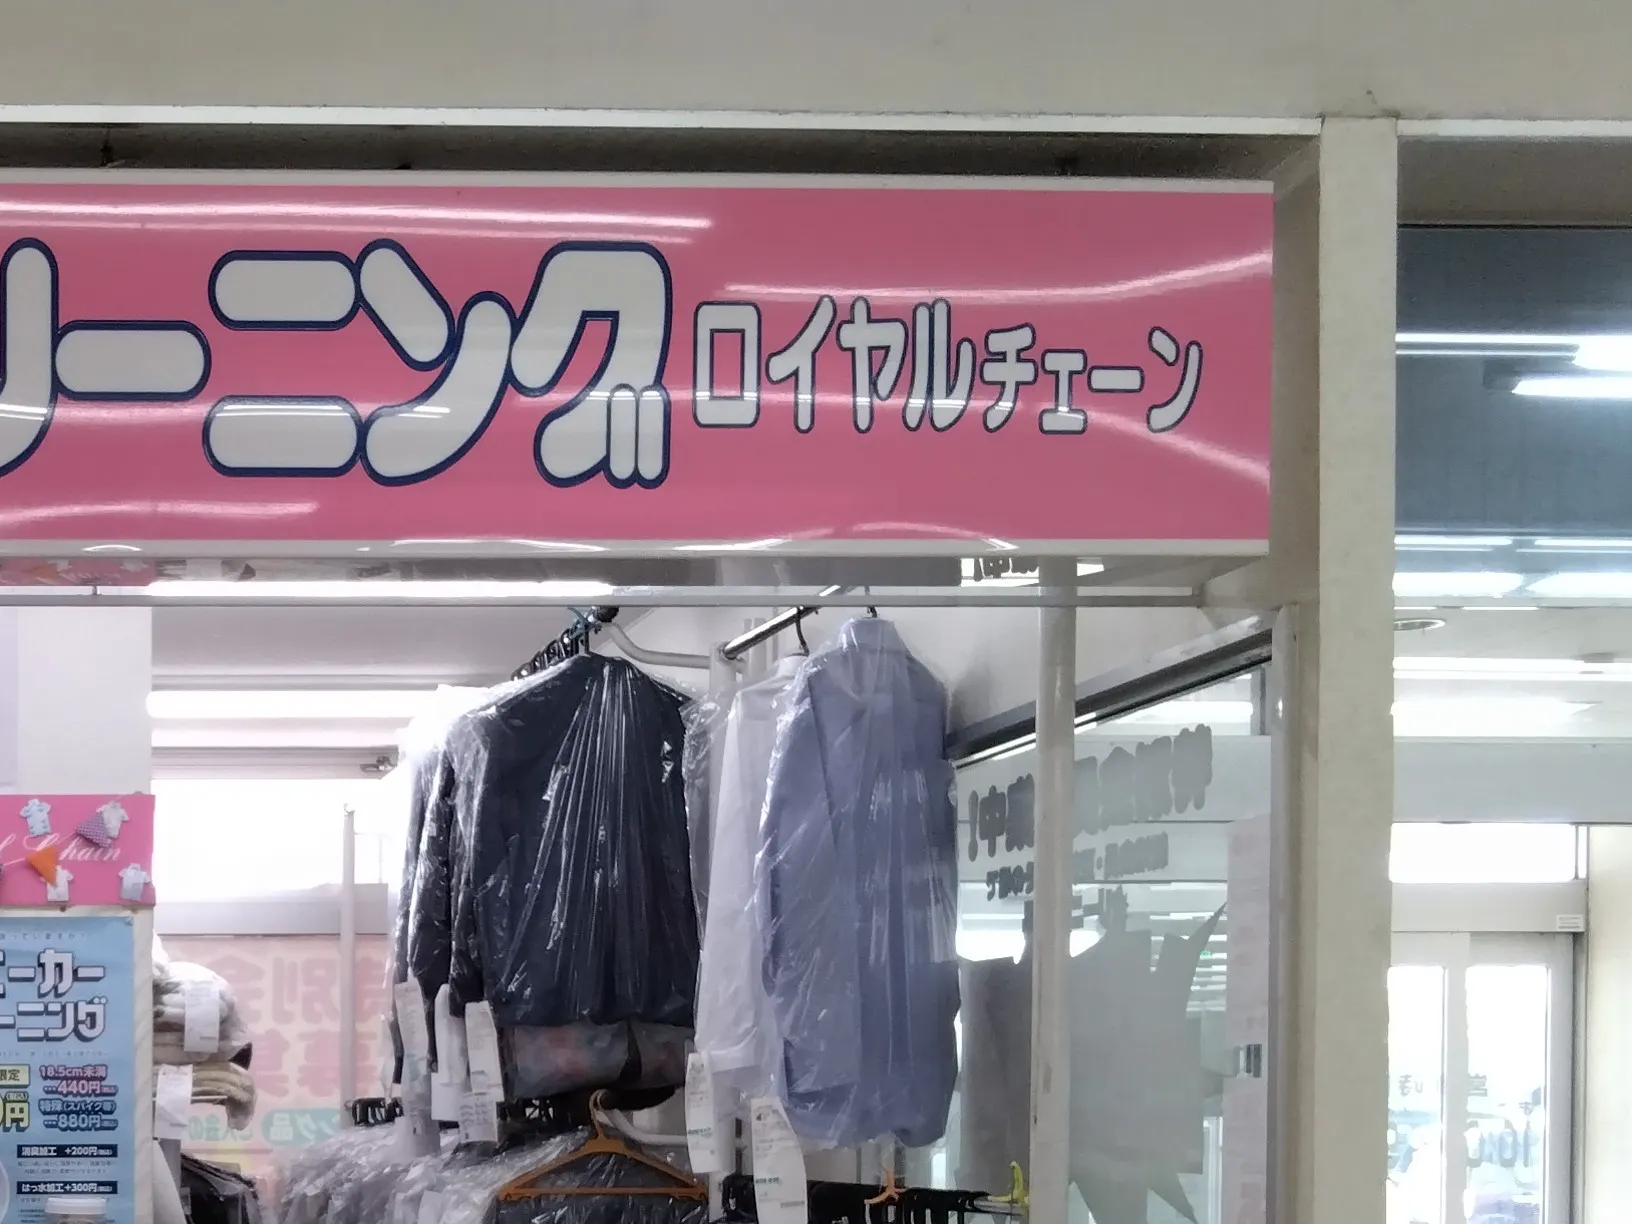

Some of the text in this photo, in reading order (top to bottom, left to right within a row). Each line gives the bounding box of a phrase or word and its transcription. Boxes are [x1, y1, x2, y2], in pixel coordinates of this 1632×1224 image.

[692, 295, 1204, 436] ロイヤルチェーン
[38, 1064, 108, 1081] 18.5cm未満
